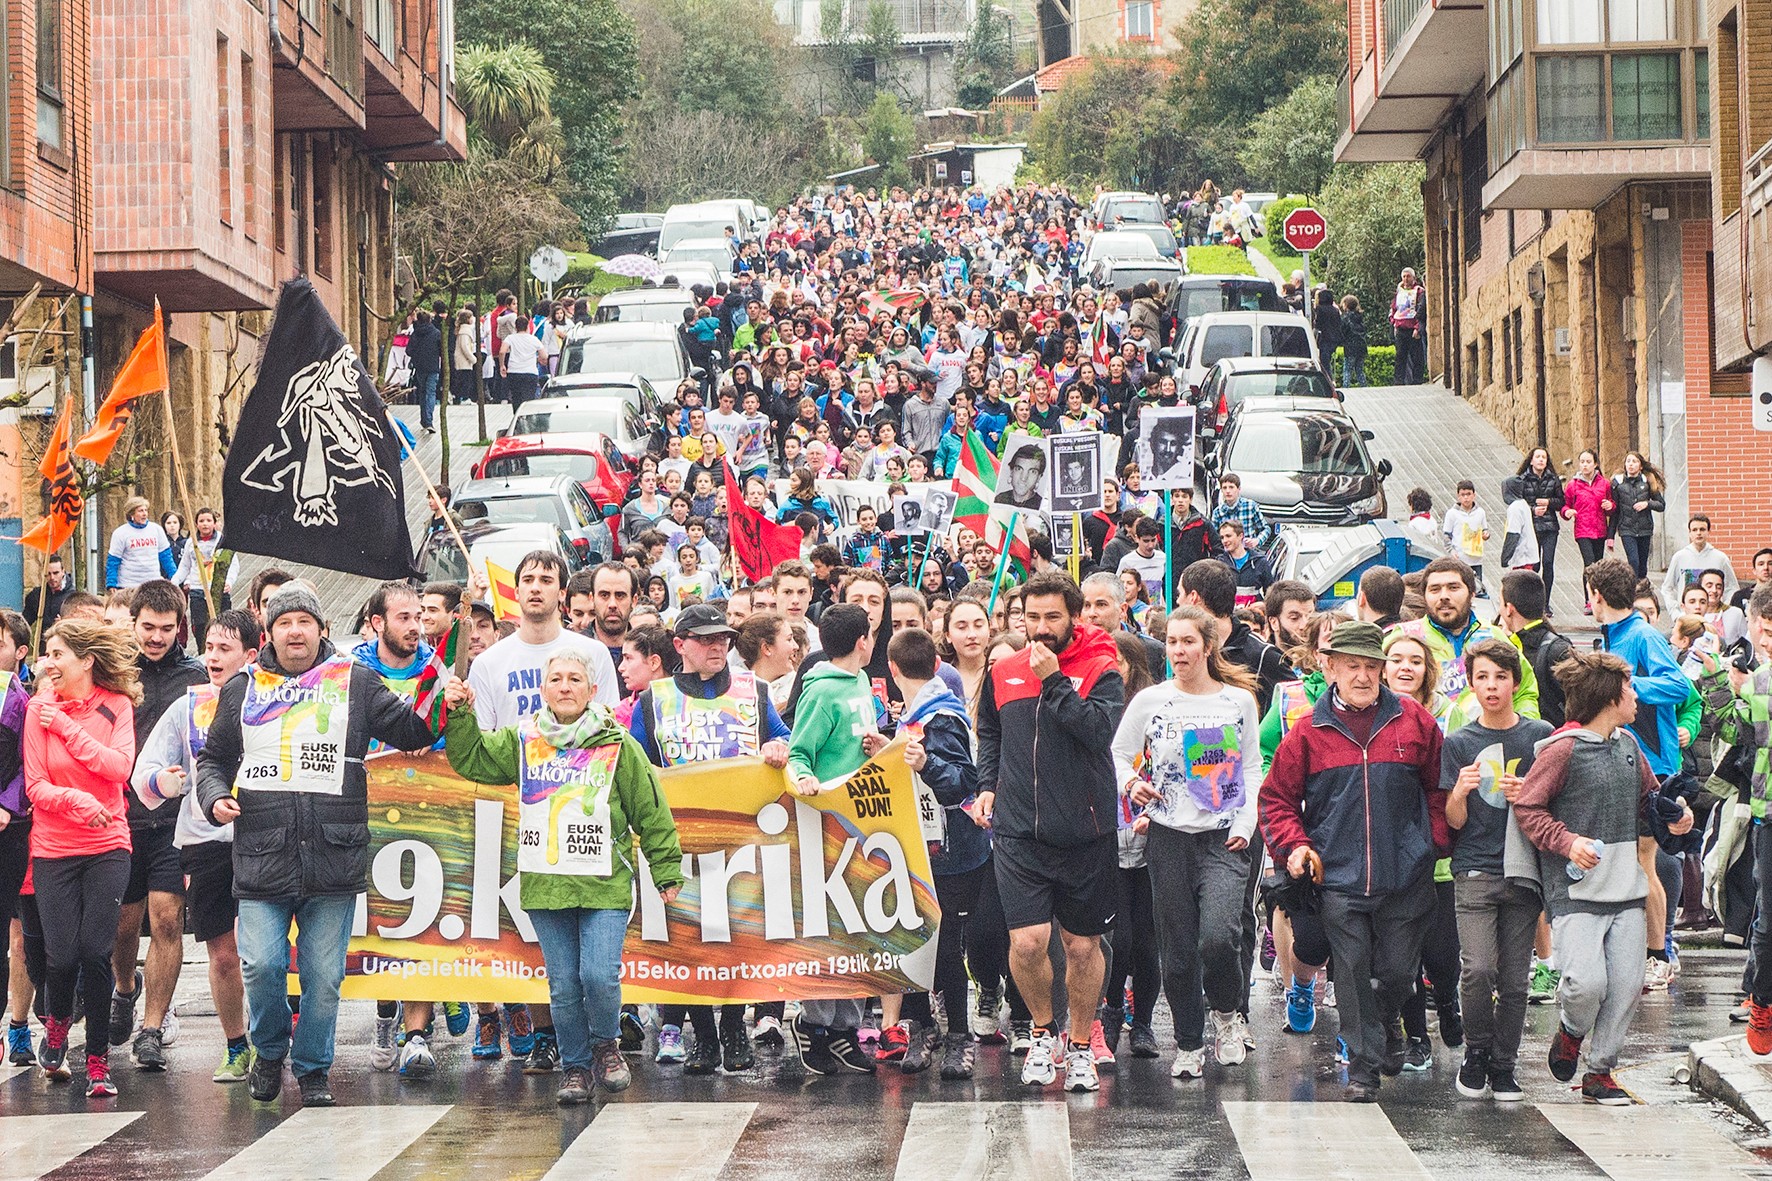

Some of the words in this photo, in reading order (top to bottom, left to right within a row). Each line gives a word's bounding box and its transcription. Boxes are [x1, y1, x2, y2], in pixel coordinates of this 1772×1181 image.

[1289, 224, 1322, 236] STOP
[282, 675, 301, 689] aek
[733, 678, 752, 690] aek
[661, 709, 724, 730] EUSK
[662, 726, 724, 744] AHAL
[301, 743, 338, 754] EUSK
[666, 742, 721, 760] DUN!
[1203, 750, 1224, 759] 1263
[300, 752, 337, 763] AHAL
[245, 765, 278, 779] 1263
[301, 761, 335, 773] DUN!
[527, 760, 606, 788] 19.korrika
[845, 776, 890, 799] AHAL
[854, 797, 893, 819] DUN!
[567, 824, 604, 835] EUSK
[566, 834, 603, 845] AHAL
[567, 844, 601, 856] DUN!
[362, 956, 483, 980] Urepeletik
[697, 960, 820, 981] martxoaren
[827, 953, 871, 975] 19tik
